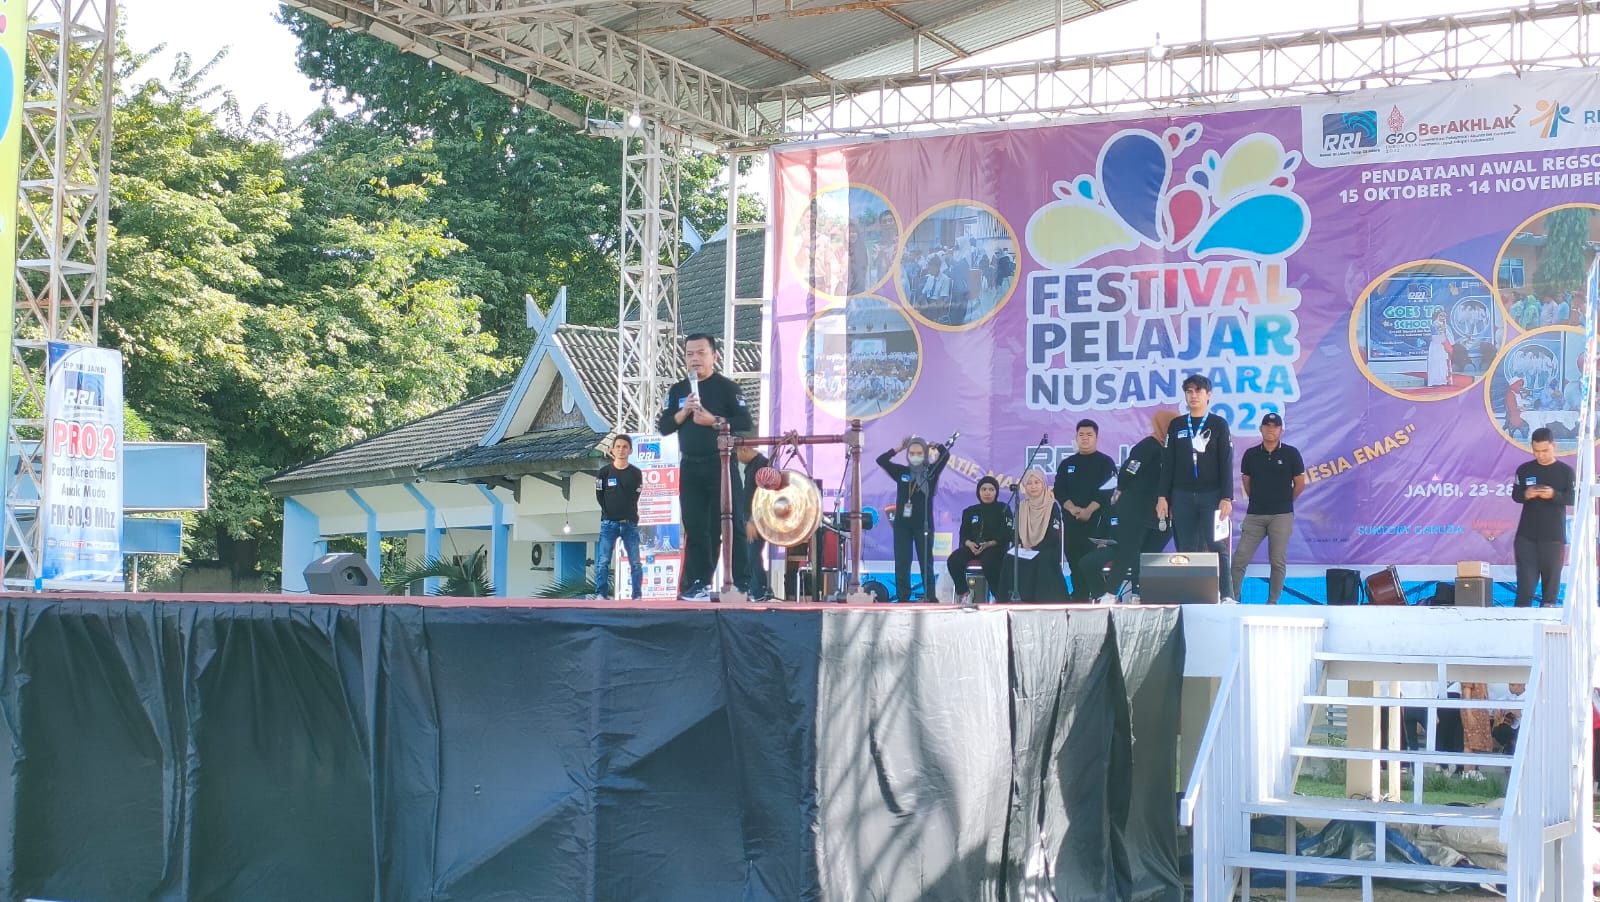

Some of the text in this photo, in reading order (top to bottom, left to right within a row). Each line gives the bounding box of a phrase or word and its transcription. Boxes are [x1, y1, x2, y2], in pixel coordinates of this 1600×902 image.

[1419, 116, 1516, 136] BerAKHLAK
[1324, 132, 1361, 151] RRI
[1386, 132, 1417, 145] G20
[1361, 163, 1475, 184] PENDATAAN
[1480, 159, 1536, 175] AWAL
[1339, 189, 1358, 203] 15
[1364, 183, 1452, 202] OKTOBER
[1469, 180, 1490, 195] 14
[1032, 264, 1298, 315] FESTIVAL
[1383, 305, 1420, 319] GOES
[1032, 314, 1294, 365] PELAJAR
[64, 388, 96, 406] RRI
[53, 419, 117, 462] PRO 2
[1353, 423, 1416, 465] EMAS"
[666, 470, 675, 483] 1
[1404, 482, 1464, 498] JAMBI,
[51, 504, 116, 529] FM 90,9 Mhz
